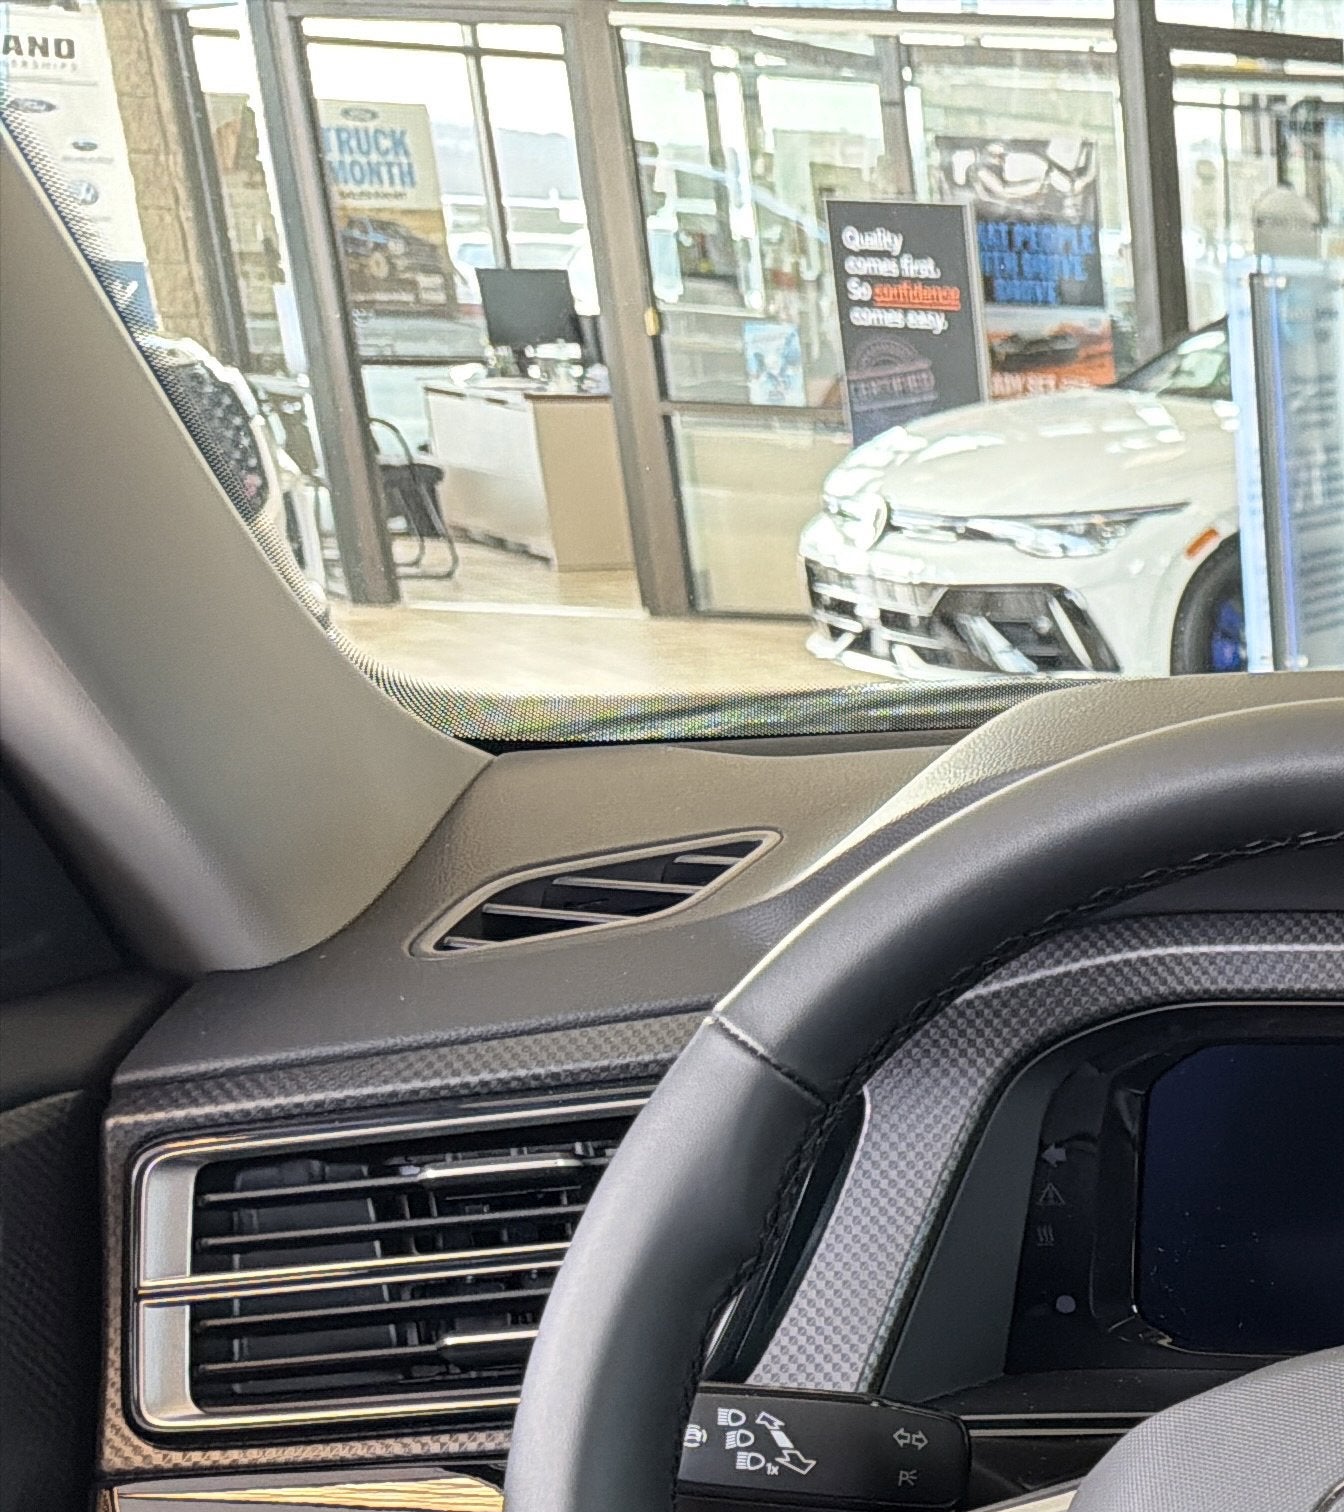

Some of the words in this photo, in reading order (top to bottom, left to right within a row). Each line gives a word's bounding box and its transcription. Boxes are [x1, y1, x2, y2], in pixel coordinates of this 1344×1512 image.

[321, 126, 412, 158] TRUCK
[841, 224, 903, 257] Quality
[845, 254, 899, 278] comes
[900, 252, 942, 280] first.
[846, 276, 873, 301] So
[873, 280, 961, 305] confidence
[850, 306, 905, 328] comes
